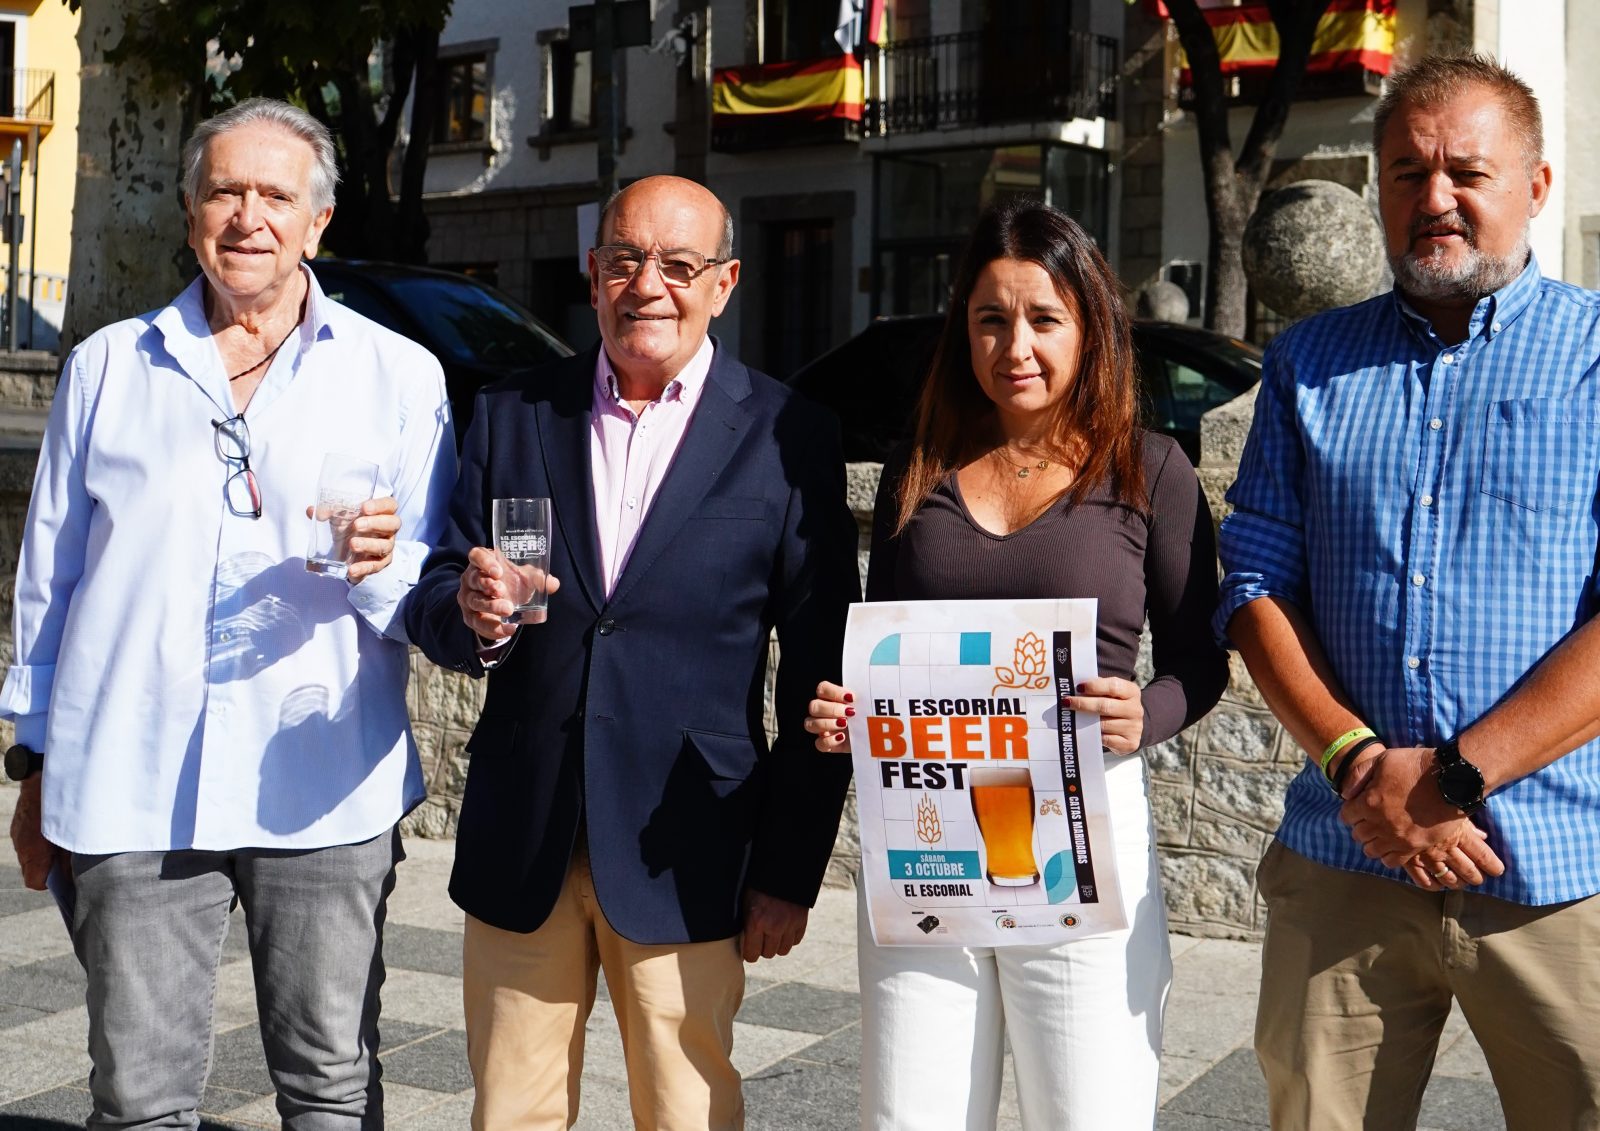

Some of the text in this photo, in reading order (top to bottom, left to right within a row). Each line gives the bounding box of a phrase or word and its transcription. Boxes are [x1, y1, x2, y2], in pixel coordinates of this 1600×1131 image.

[501, 541, 537, 551] BEER
[874, 698, 1026, 716] EL ESCORIAL
[867, 717, 1029, 760] BEER
[881, 761, 967, 790] FEST
[1059, 678, 1088, 864] ACTUIONES MUSICALES CATAS MARIDADAS
[904, 863, 965, 876] 3 OCTUBRE
[904, 884, 973, 897] EL ESCORIAL
